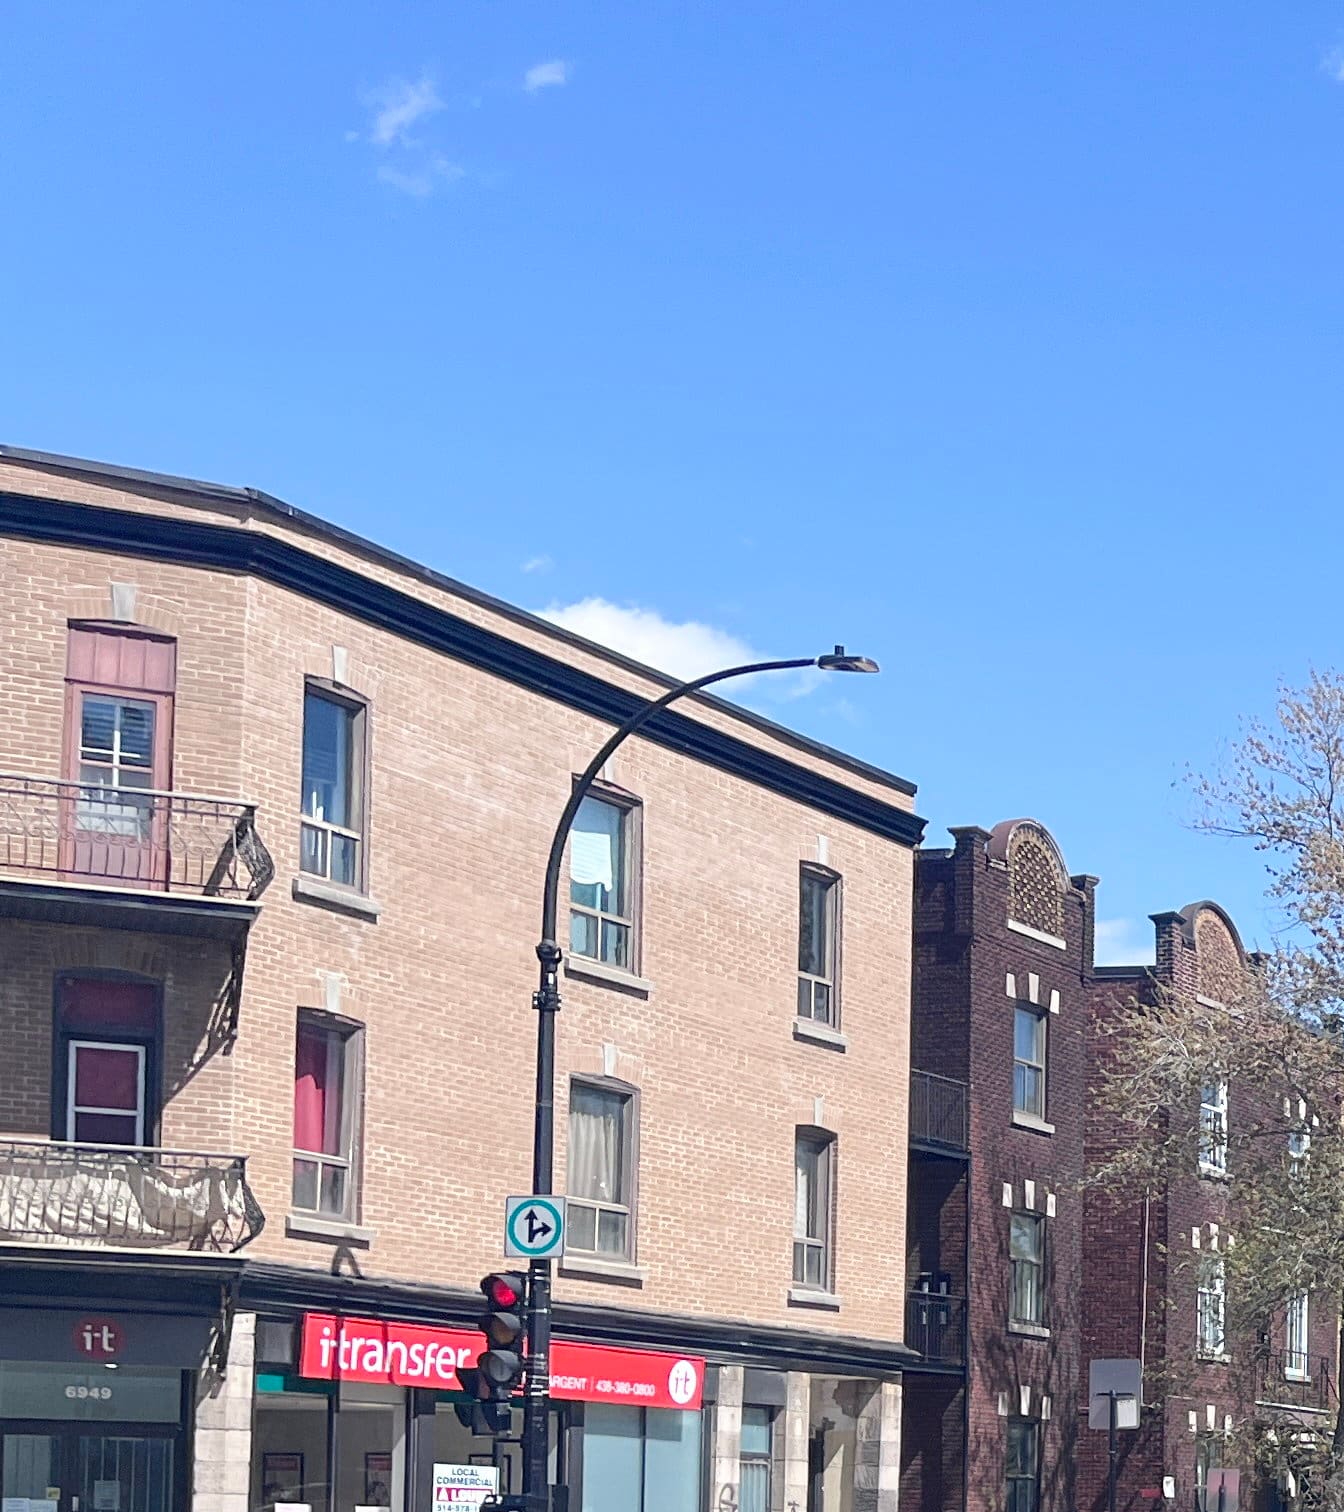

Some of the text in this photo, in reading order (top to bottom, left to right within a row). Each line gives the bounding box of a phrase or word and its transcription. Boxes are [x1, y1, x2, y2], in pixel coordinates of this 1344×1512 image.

[65, 1385, 112, 1400] 6949
[451, 1468, 480, 1477] LOCAL
[436, 1477, 493, 1487] COMMERCIAL
